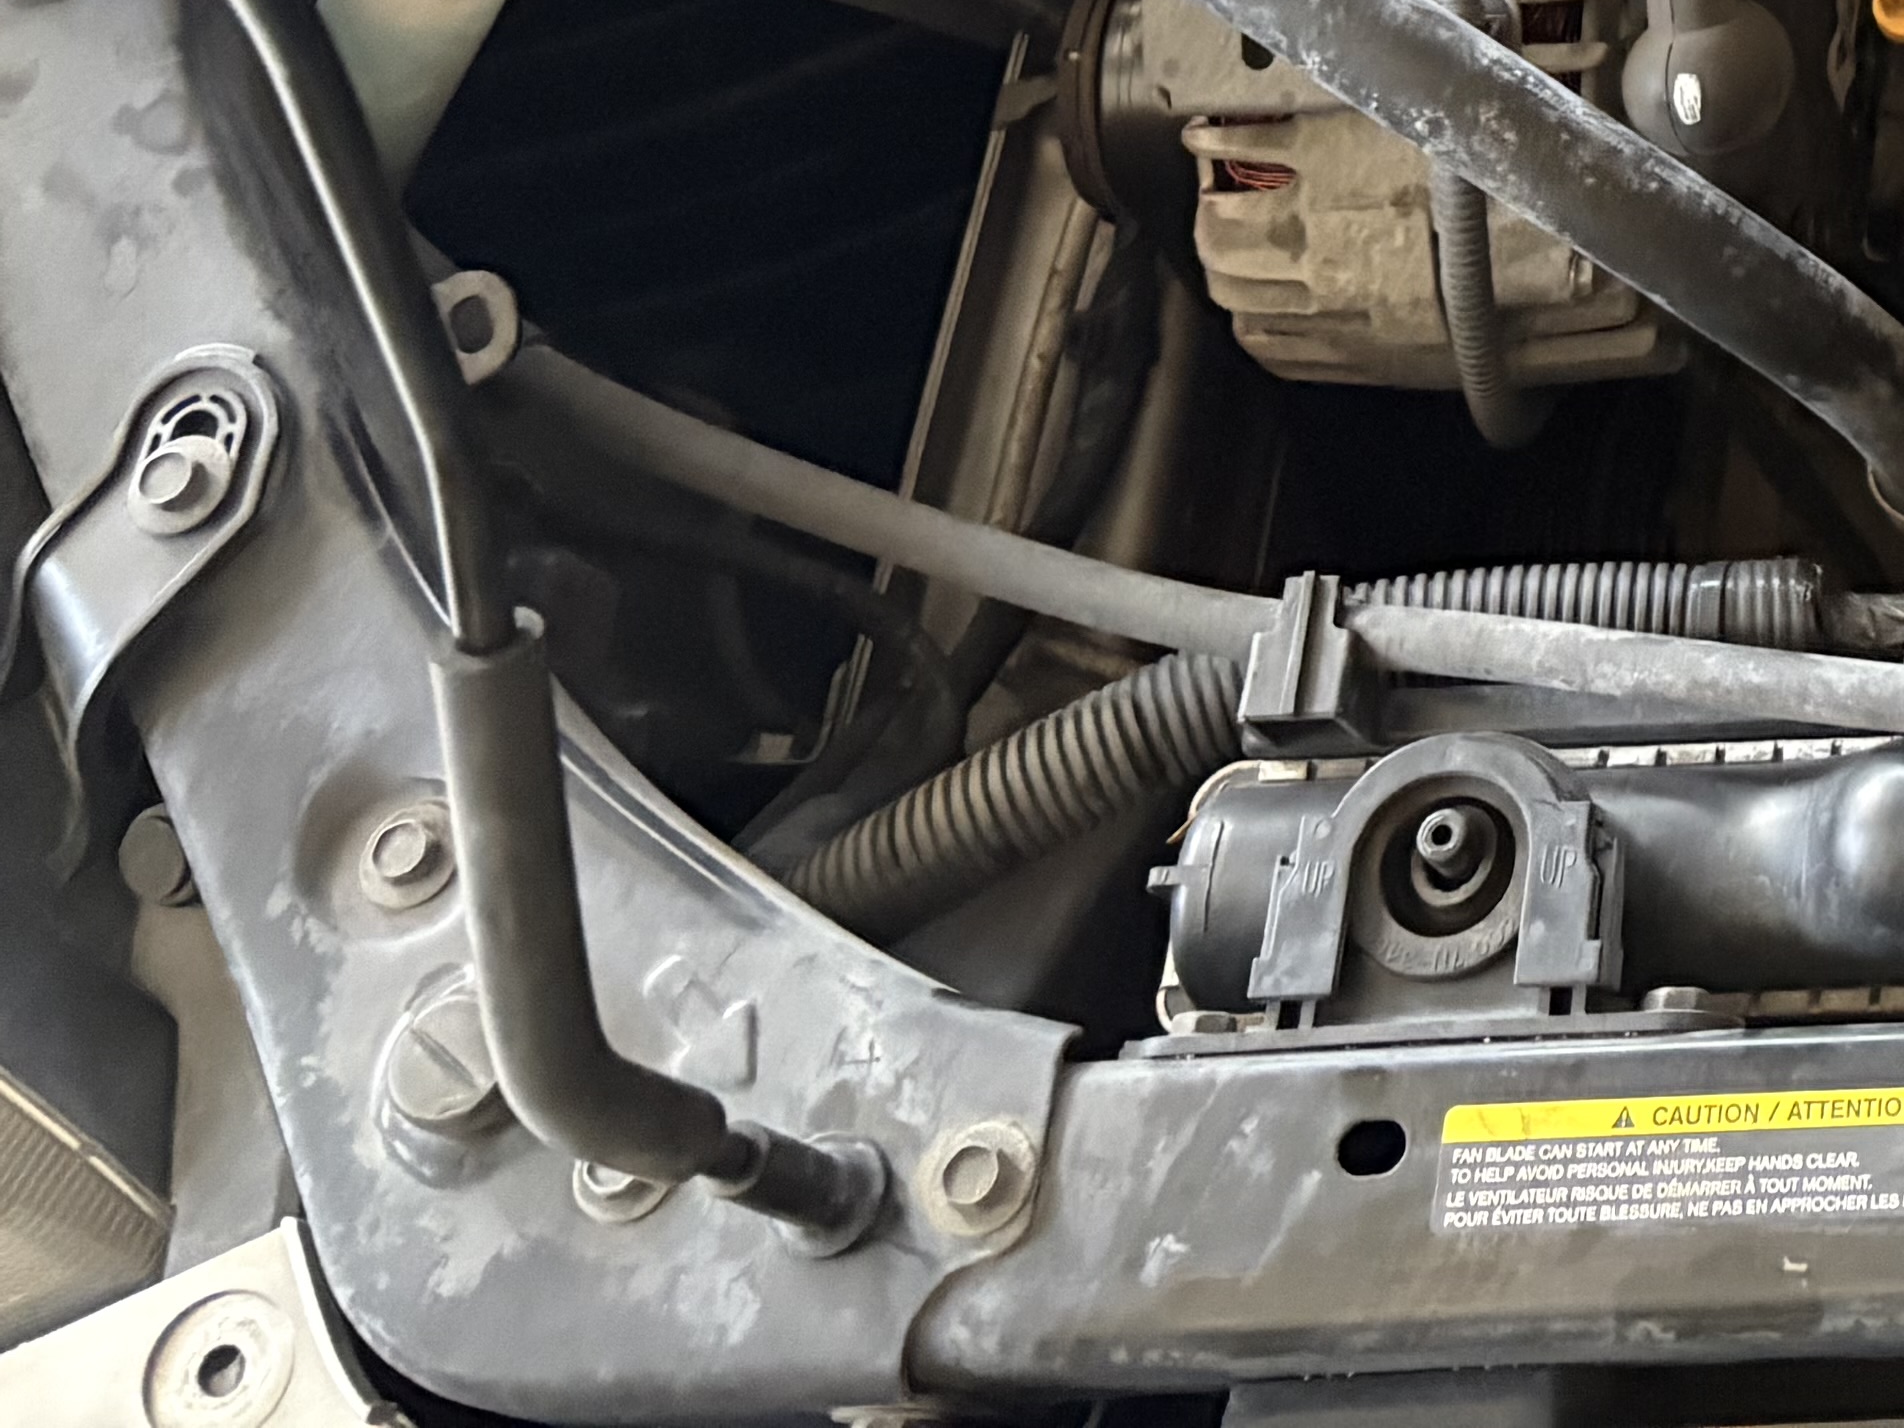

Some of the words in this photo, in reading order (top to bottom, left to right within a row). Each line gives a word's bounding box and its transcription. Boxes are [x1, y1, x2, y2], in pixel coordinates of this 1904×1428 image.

[1302, 861, 1335, 898] UP
[1540, 843, 1577, 889] UP
[1652, 1105, 1758, 1128] CAUTION
[1451, 1167, 1472, 1183] TO
[1474, 1165, 1515, 1183] HELP
[1515, 1163, 1565, 1181] AVOID
[1566, 1159, 1649, 1178] PERSONAL
[1748, 1152, 1803, 1171] HANDS
[1452, 1147, 1482, 1164] FAN
[1485, 1146, 1536, 1163] BLADE
[1538, 1144, 1572, 1160] CAN
[1576, 1142, 1623, 1158] START
[1625, 1141, 1643, 1156] AT
[1646, 1139, 1681, 1155] ANY
[1683, 1137, 1720, 1154] TIME.
[1446, 1191, 1465, 1207] LE
[1468, 1185, 1570, 1207] VENTILATEUR
[1570, 1183, 1629, 1202] RISQUE
[1631, 1182, 1654, 1199] DE
[1656, 1176, 1742, 1198] DÉMARRER
[1744, 1173, 1757, 1195] À
[1759, 1175, 1801, 1193] TOUT
[1443, 1209, 1490, 1228] POUR
[1491, 1204, 1545, 1226] ÉVITER
[1547, 1205, 1597, 1223] TOUTE
[1687, 1201, 1709, 1218] NE
[1711, 1199, 1742, 1217] PAS
[1743, 1197, 1765, 1215] EN
[1769, 1194, 1869, 1214] APPROCHER
[1870, 1193, 1900, 1210] LES
